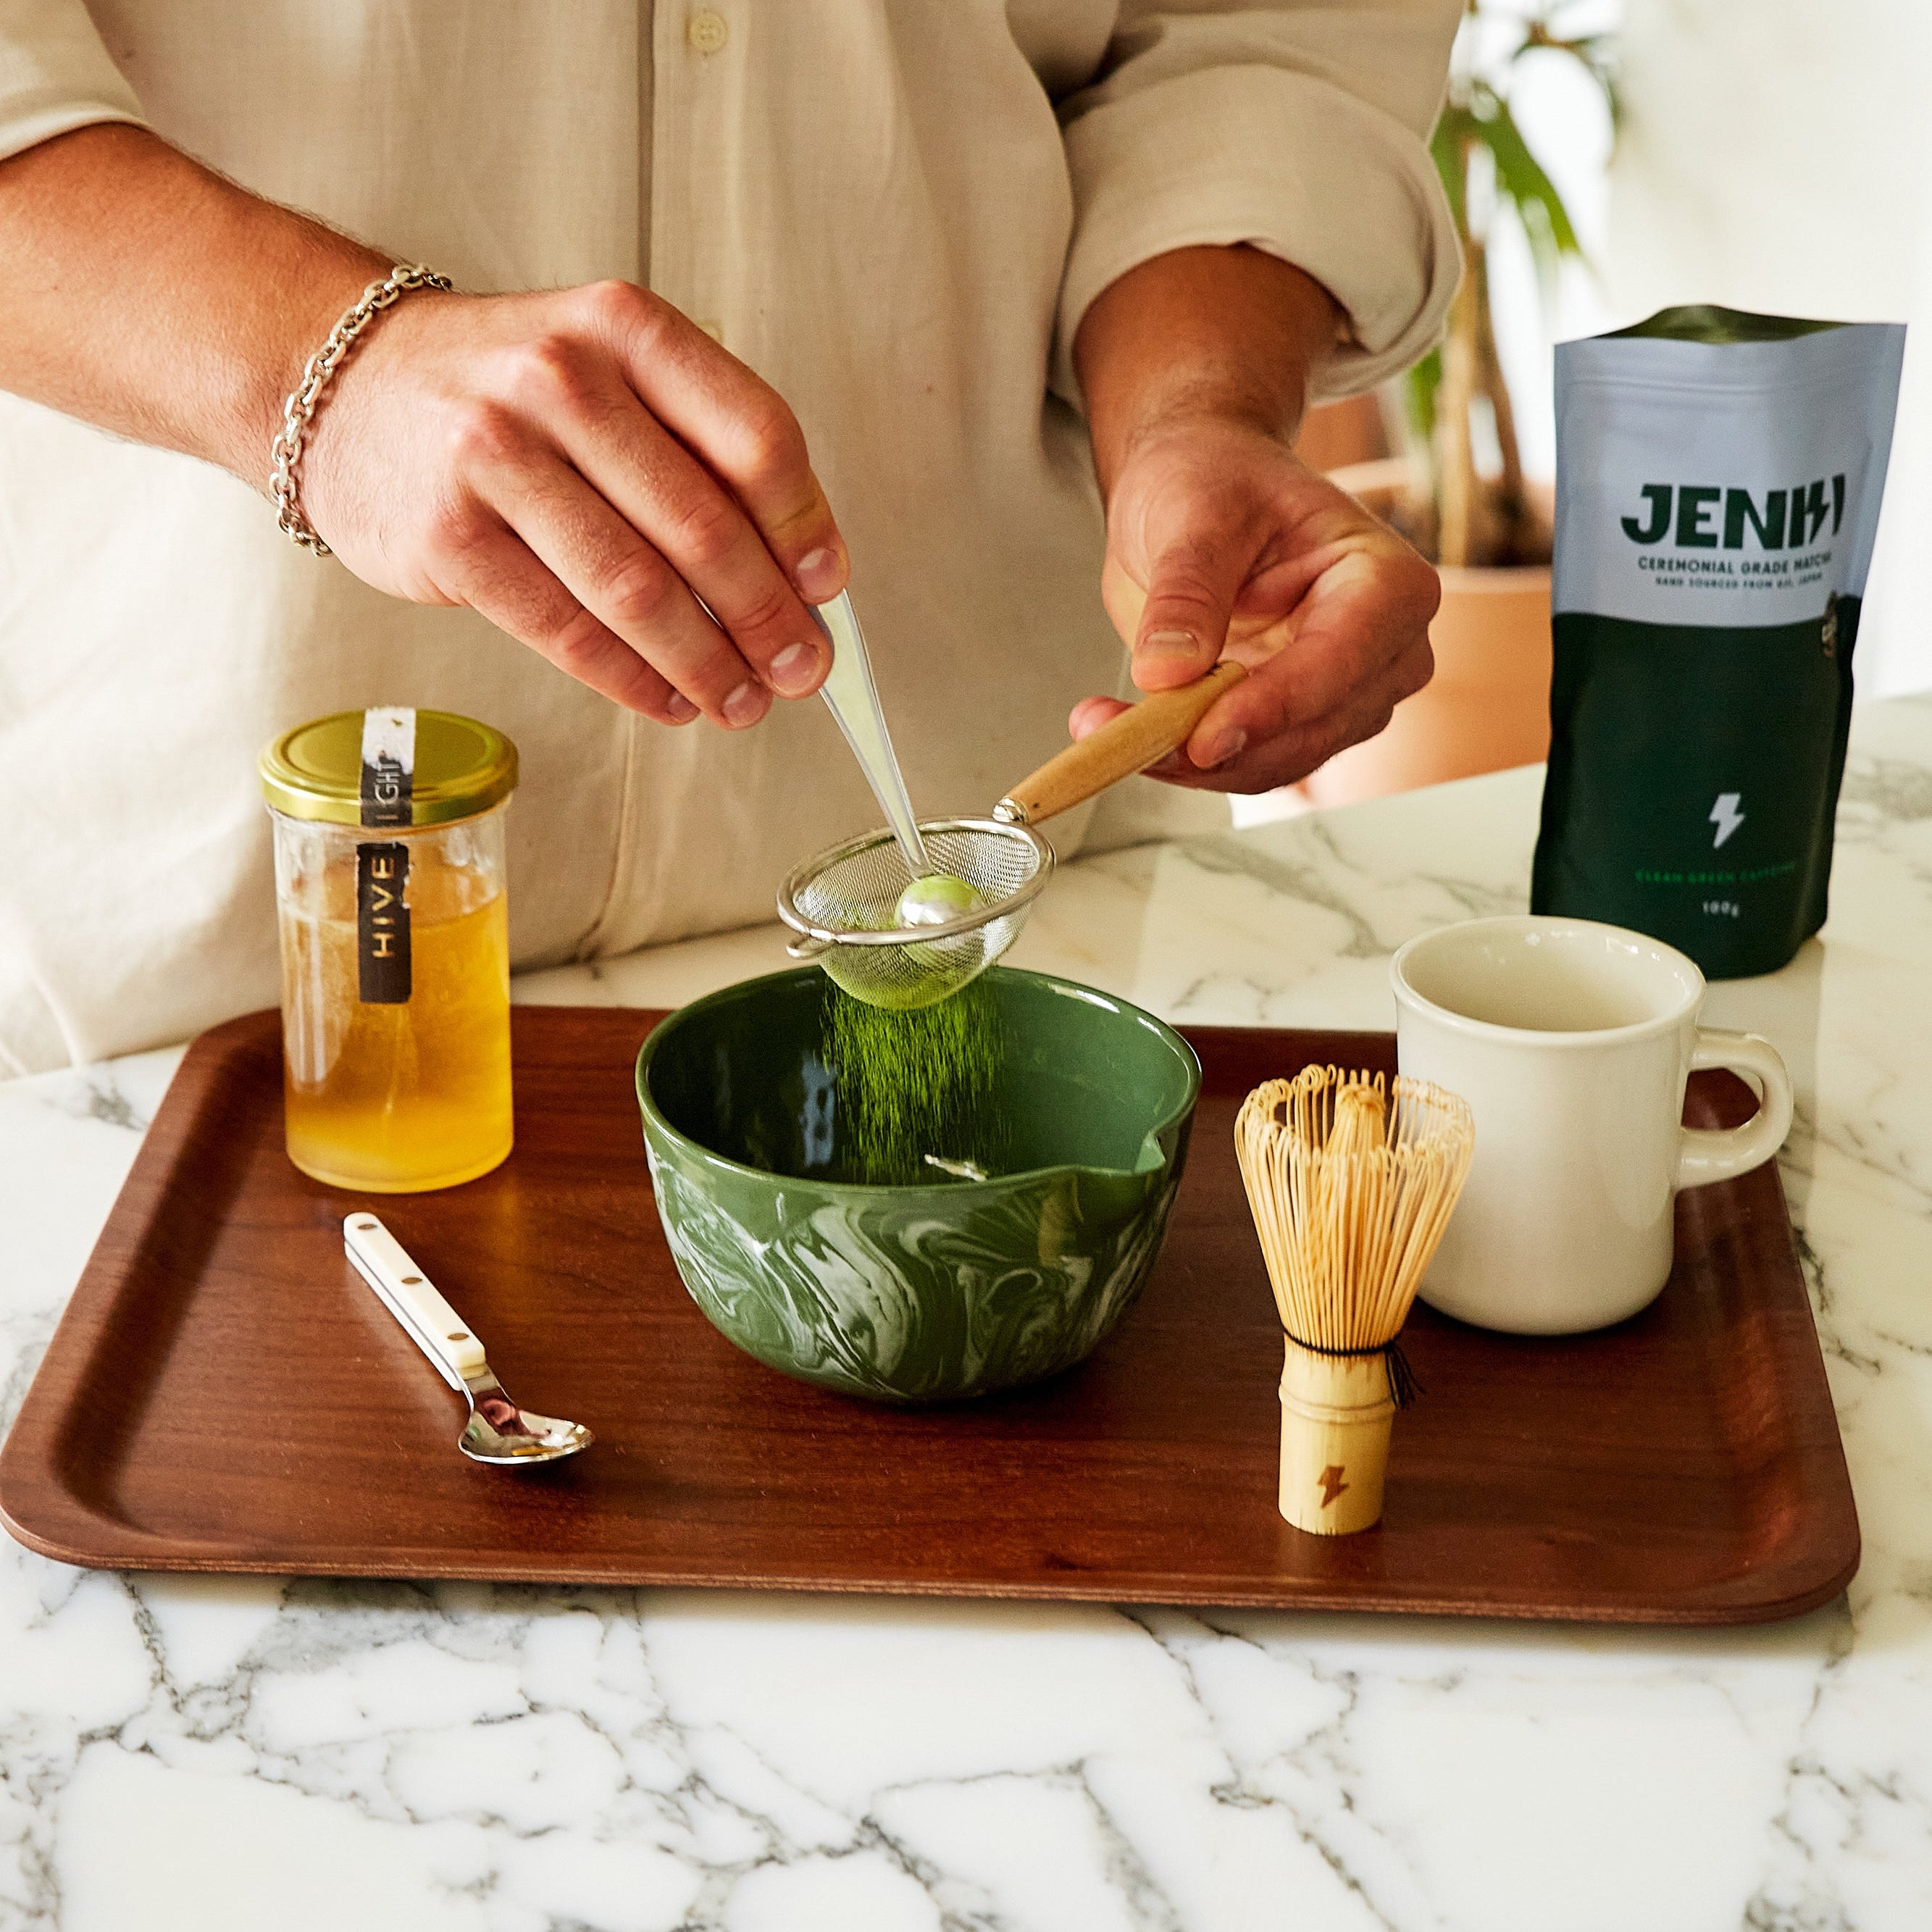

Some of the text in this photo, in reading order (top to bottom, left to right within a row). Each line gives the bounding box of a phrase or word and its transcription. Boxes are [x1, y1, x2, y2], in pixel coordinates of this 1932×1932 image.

[1637, 555, 1734, 574] CEREMONIAL
[1741, 560, 1789, 574] GRADE
[371, 858, 395, 958] HIVE
